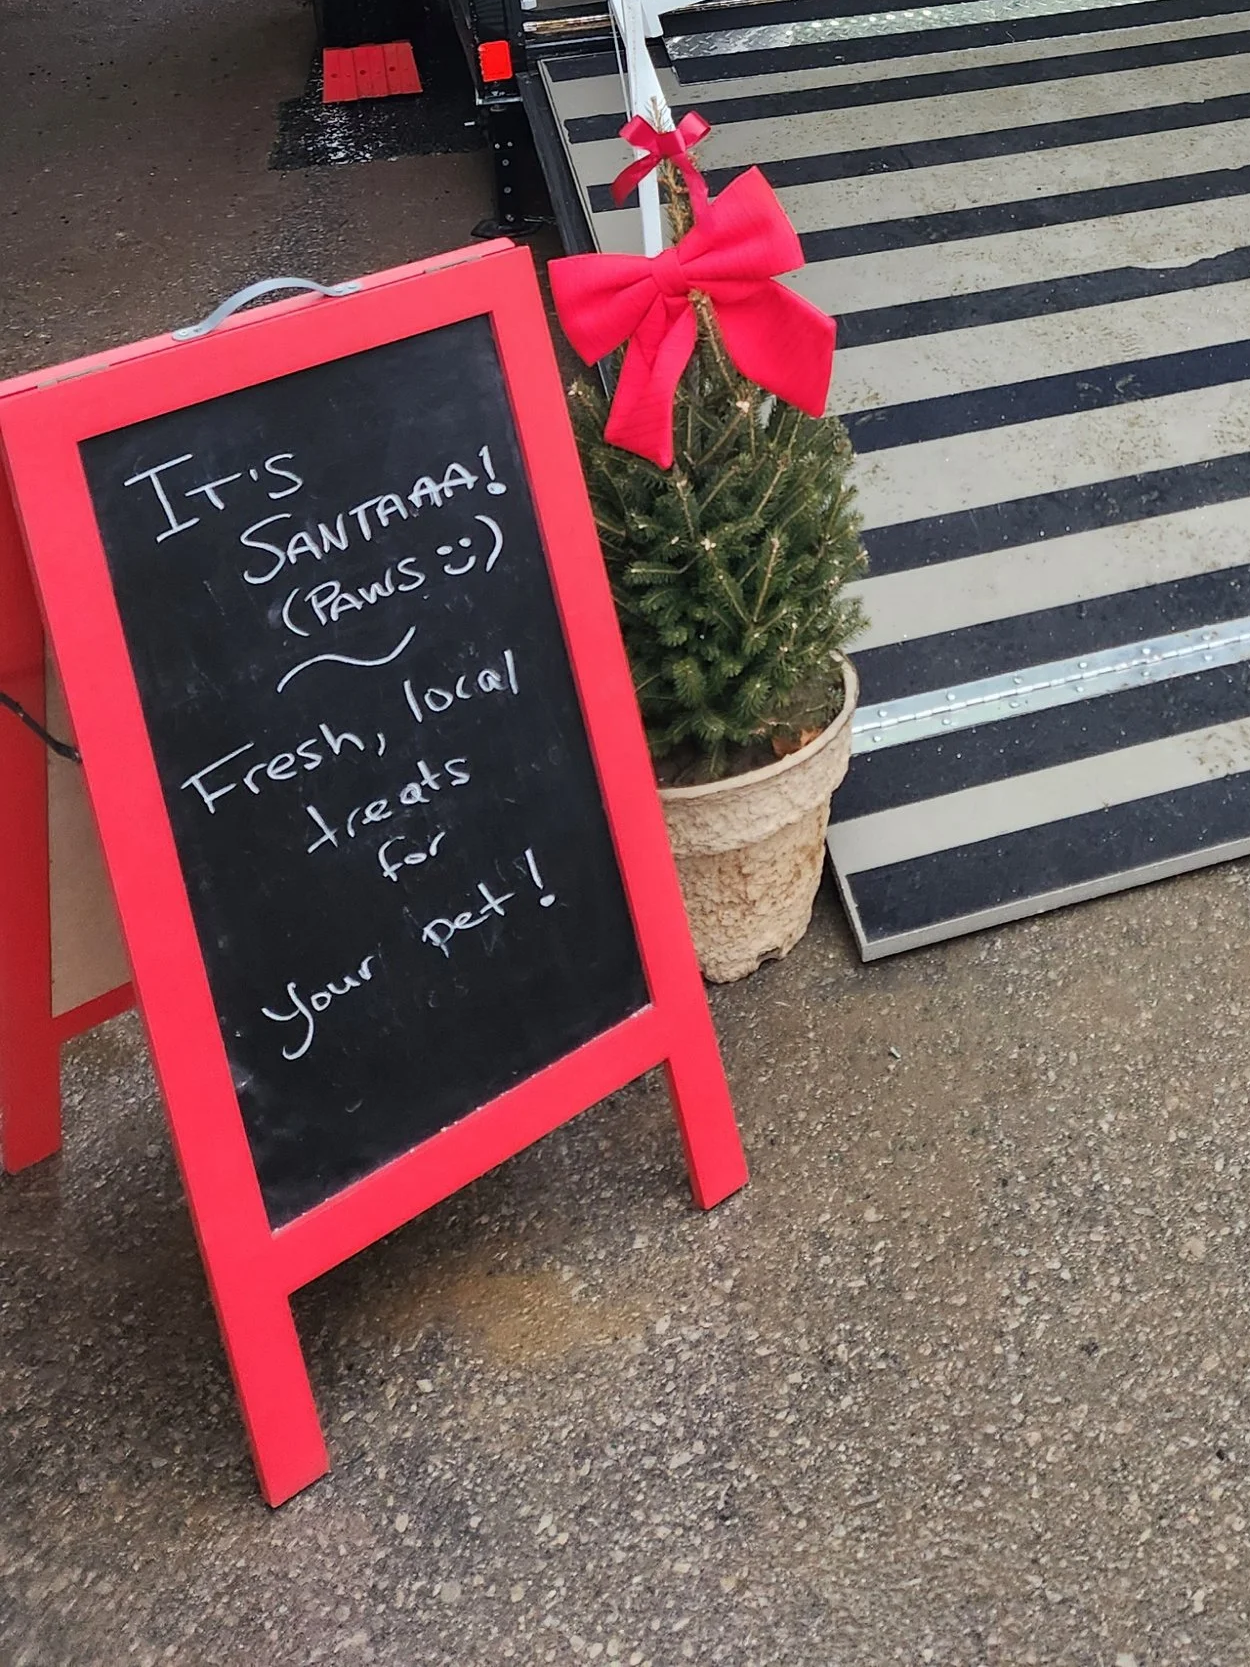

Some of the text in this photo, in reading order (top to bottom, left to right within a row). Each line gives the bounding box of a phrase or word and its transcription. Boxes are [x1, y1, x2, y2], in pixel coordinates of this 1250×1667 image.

[240, 445, 507, 585] SANTAAA!
[181, 649, 519, 814] Fresh, local
[305, 756, 471, 854] treats
[377, 831, 447, 883] for
